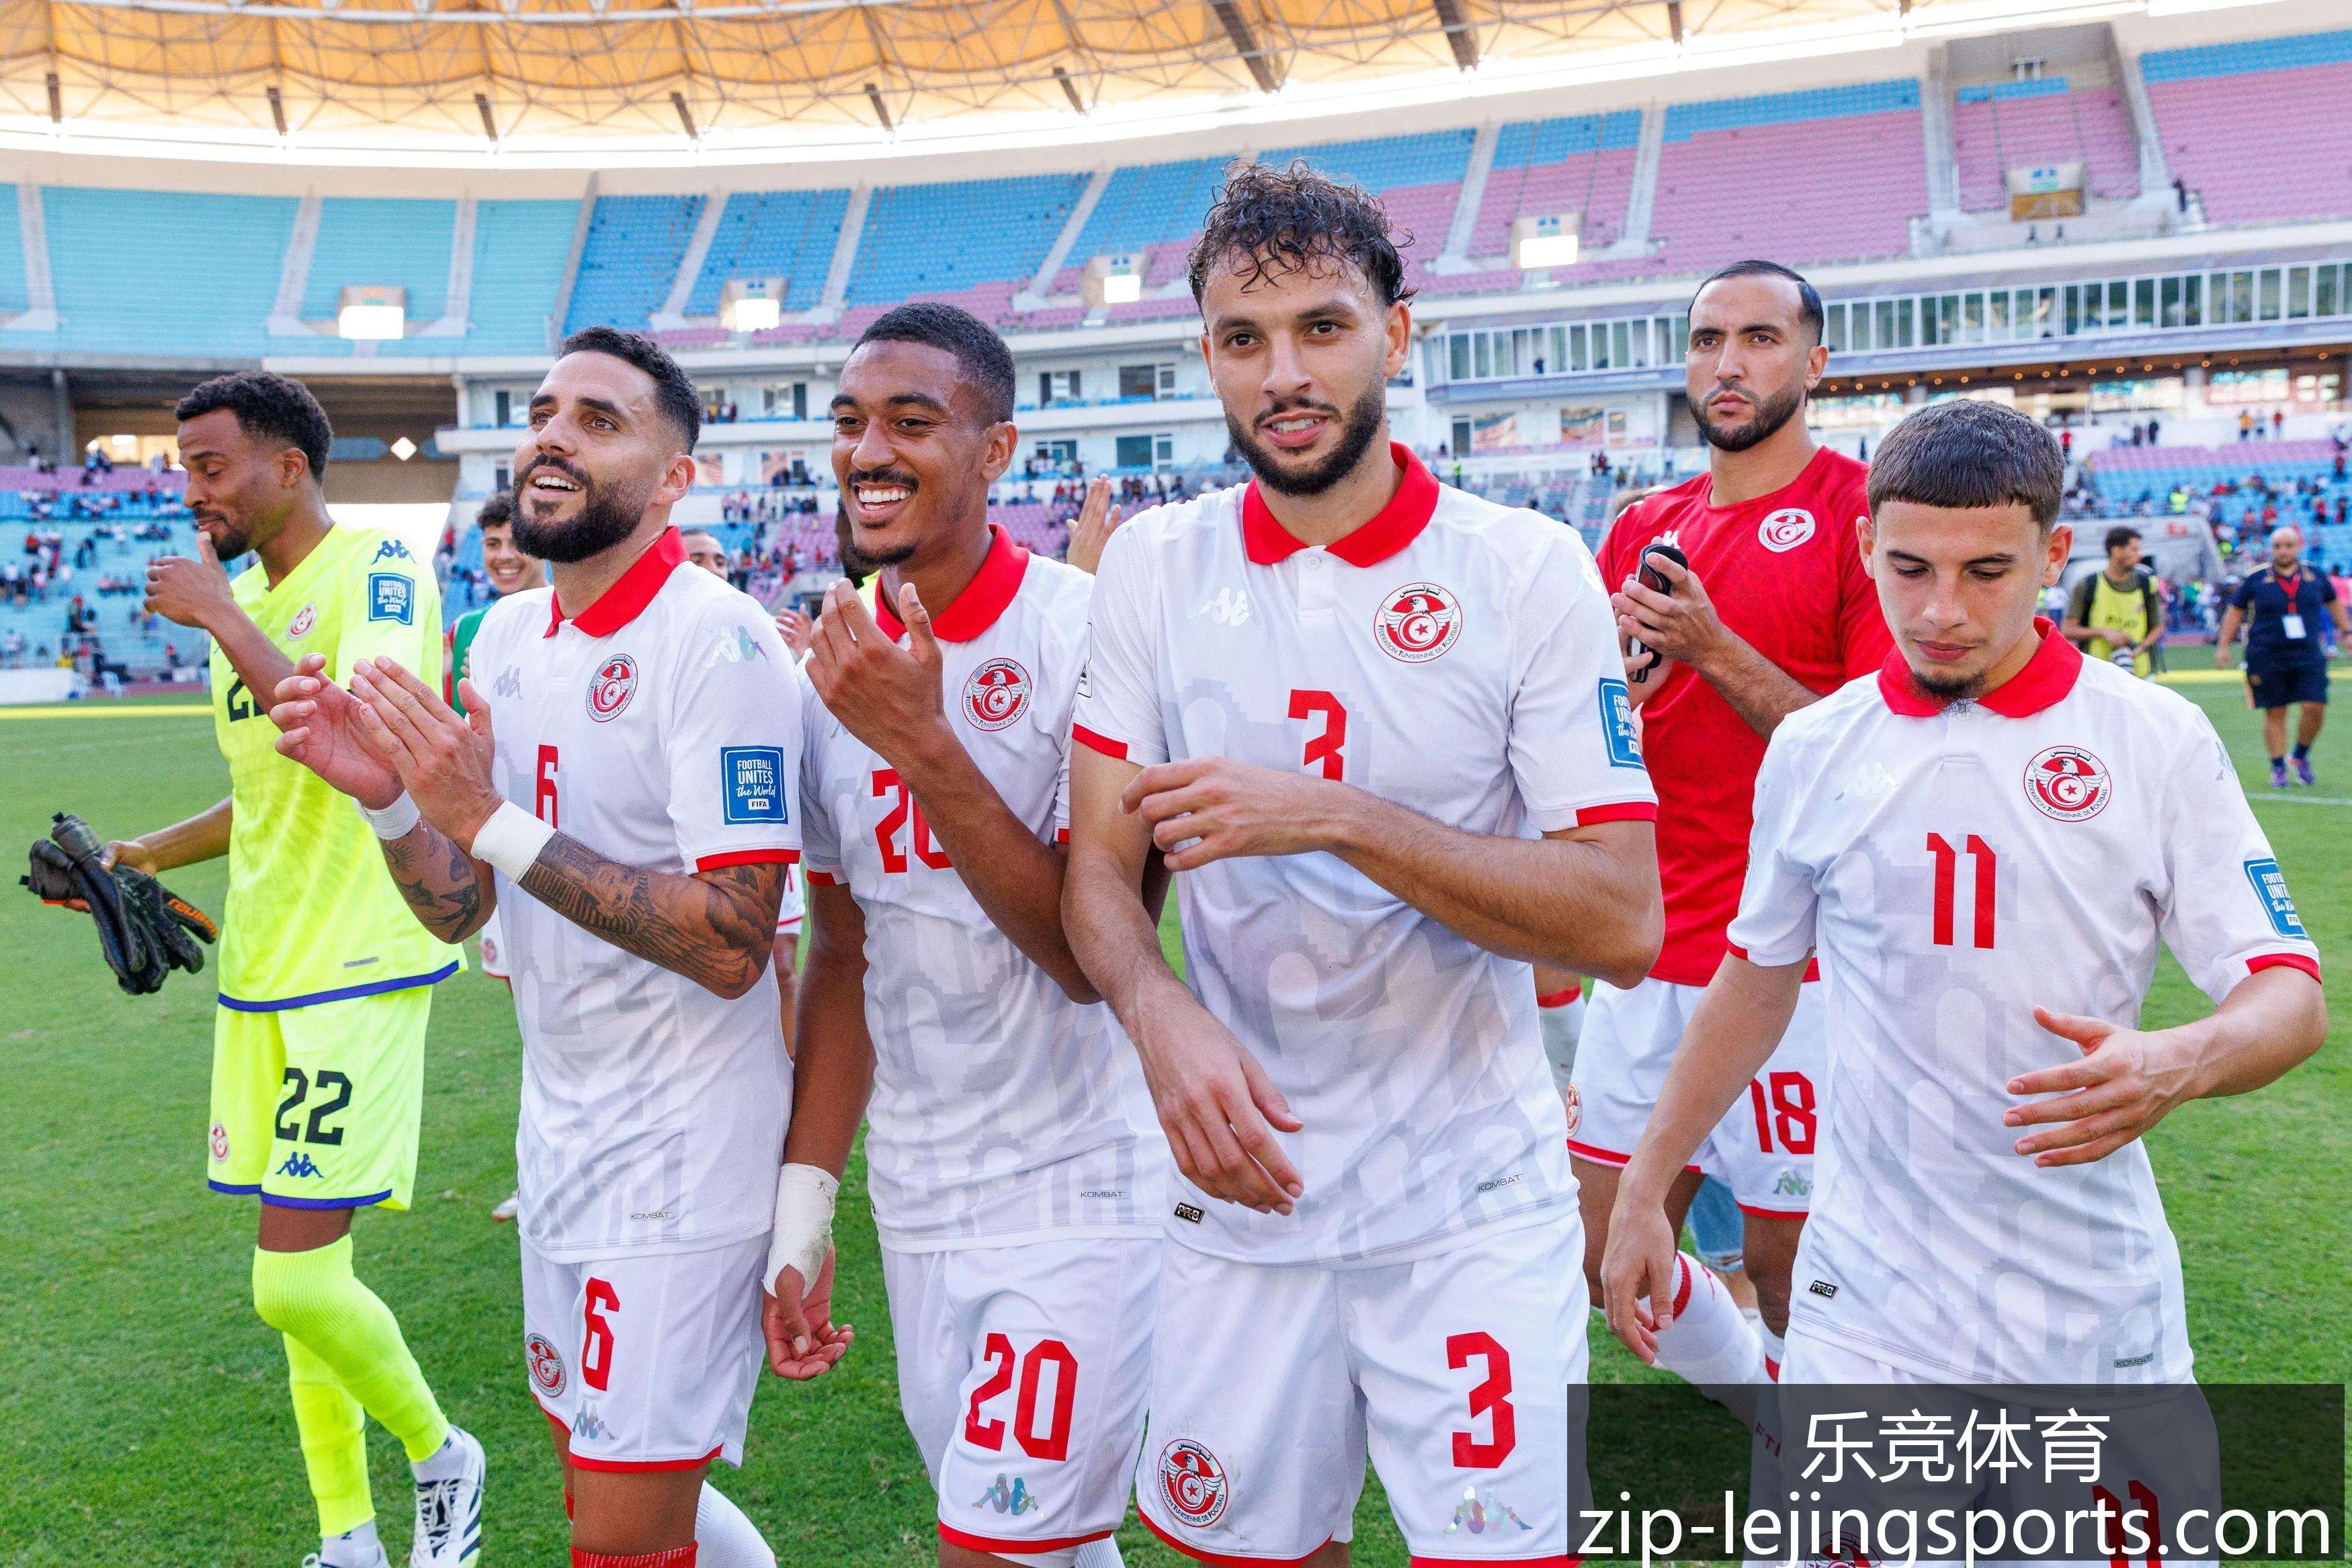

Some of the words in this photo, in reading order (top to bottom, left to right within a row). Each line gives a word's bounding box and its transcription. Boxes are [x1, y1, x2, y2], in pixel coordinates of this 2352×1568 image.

[1378, 625, 1398, 654] FEDERATION
[1398, 650, 1435, 659] TUNISIENNE
[1441, 621, 1459, 648] FOOTBALL
[737, 759, 772, 770] FOOTBALL
[1288, 689, 1347, 782] 3
[536, 744, 558, 829] 6
[736, 785, 752, 797] the
[753, 785, 776, 797] World
[738, 770, 773, 785] UNITES
[2028, 779, 2047, 809] FEDERATION
[2046, 806, 2083, 818] TUNISIENNE
[2090, 789, 2108, 812] FOOTBALL
[1927, 832, 1997, 949] 11
[276, 1067, 353, 1146] 22
[1750, 1071, 1817, 1154] 18
[582, 1276, 620, 1392] 6
[965, 1332, 1079, 1462] 20
[1446, 1332, 1516, 1469] 3
[1161, 1469, 1173, 1506] FEDERATION
[1173, 1505, 1202, 1523] TUNISIENNE
[1208, 1493, 1224, 1518] FOOTBALL
